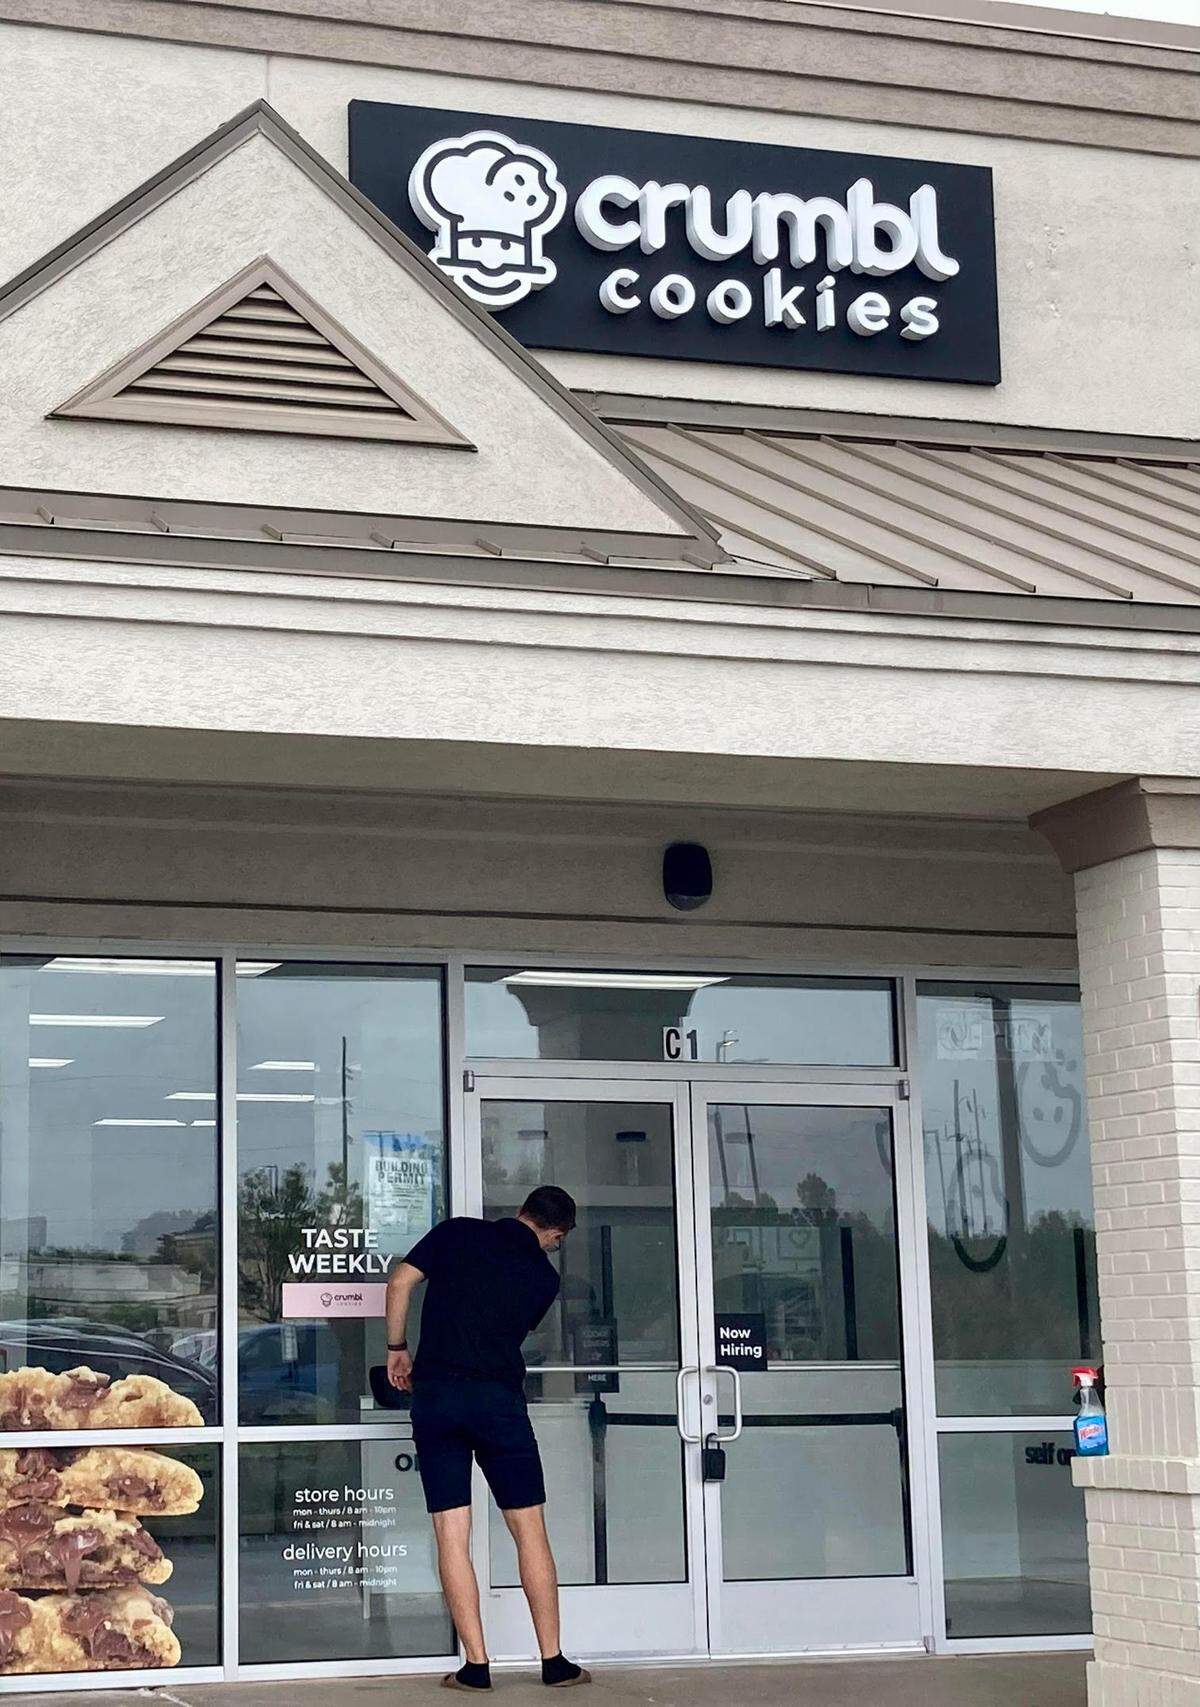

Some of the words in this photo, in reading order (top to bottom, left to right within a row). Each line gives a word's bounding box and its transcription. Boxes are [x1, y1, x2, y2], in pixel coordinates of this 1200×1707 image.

[575, 175, 960, 281] crumbl
[600, 268, 939, 340] cookies
[665, 1028, 698, 1060] C1
[378, 1172, 425, 1185] PERMIT
[301, 1228, 378, 1248] TASTE
[288, 1254, 394, 1274] WEEKLY
[719, 1327, 751, 1339] Now
[720, 1344, 763, 1359] Hiring
[295, 1488, 340, 1503] store
[344, 1485, 394, 1502] hours
[293, 1508, 313, 1517] mon
[293, 1520, 303, 1529] fri
[282, 1543, 353, 1562] delivery
[357, 1541, 408, 1558] hours
[293, 1568, 313, 1577] mon
[294, 1580, 304, 1590] fri
